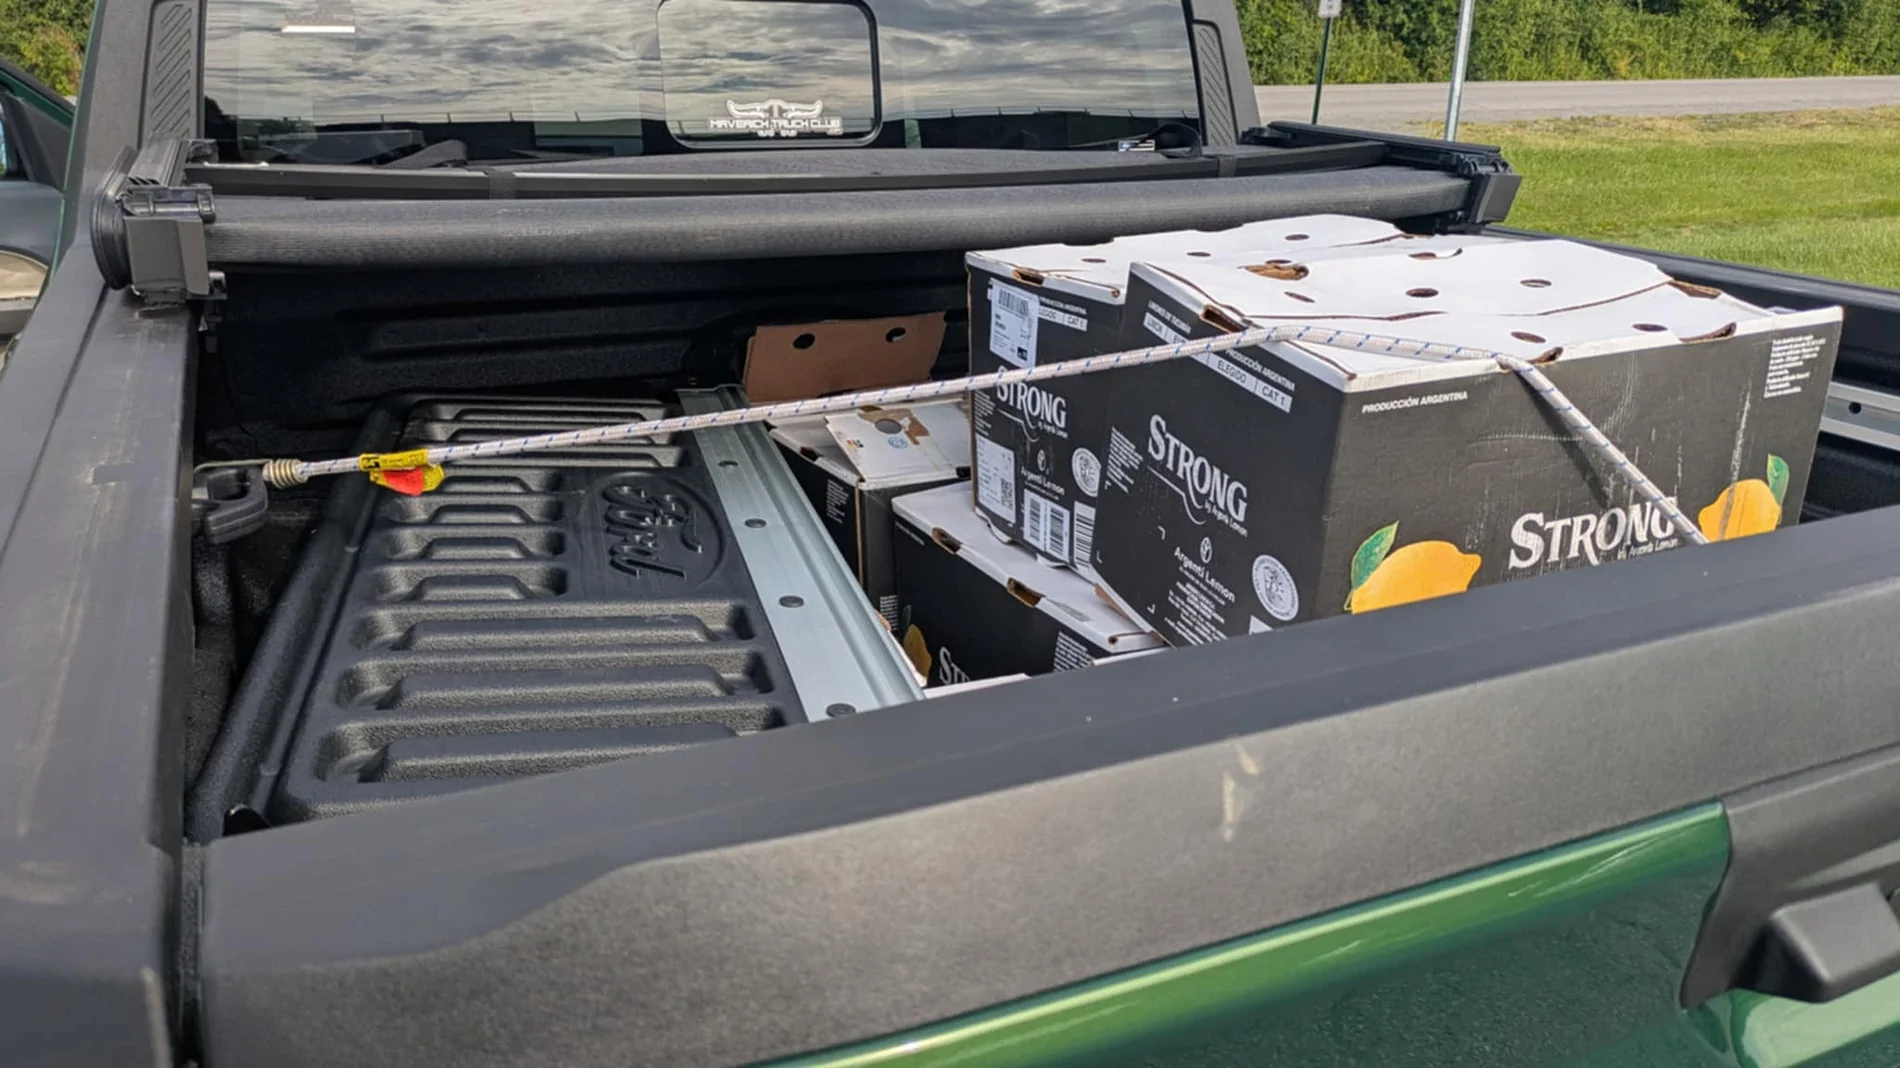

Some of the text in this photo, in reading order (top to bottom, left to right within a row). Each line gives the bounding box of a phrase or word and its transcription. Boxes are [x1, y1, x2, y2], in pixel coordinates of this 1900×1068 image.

[710, 119, 841, 129] MAVERICK TRUCK CLUB
[1217, 360, 1248, 384] ELEGIDO
[1262, 364, 1296, 391] ARGENTINA
[1262, 385, 1280, 403] CAT
[1361, 390, 1469, 414] PRODUCCIÓN ARGENTINA
[1148, 413, 1249, 523] STRONG
[1205, 570, 1236, 604] Lemon
